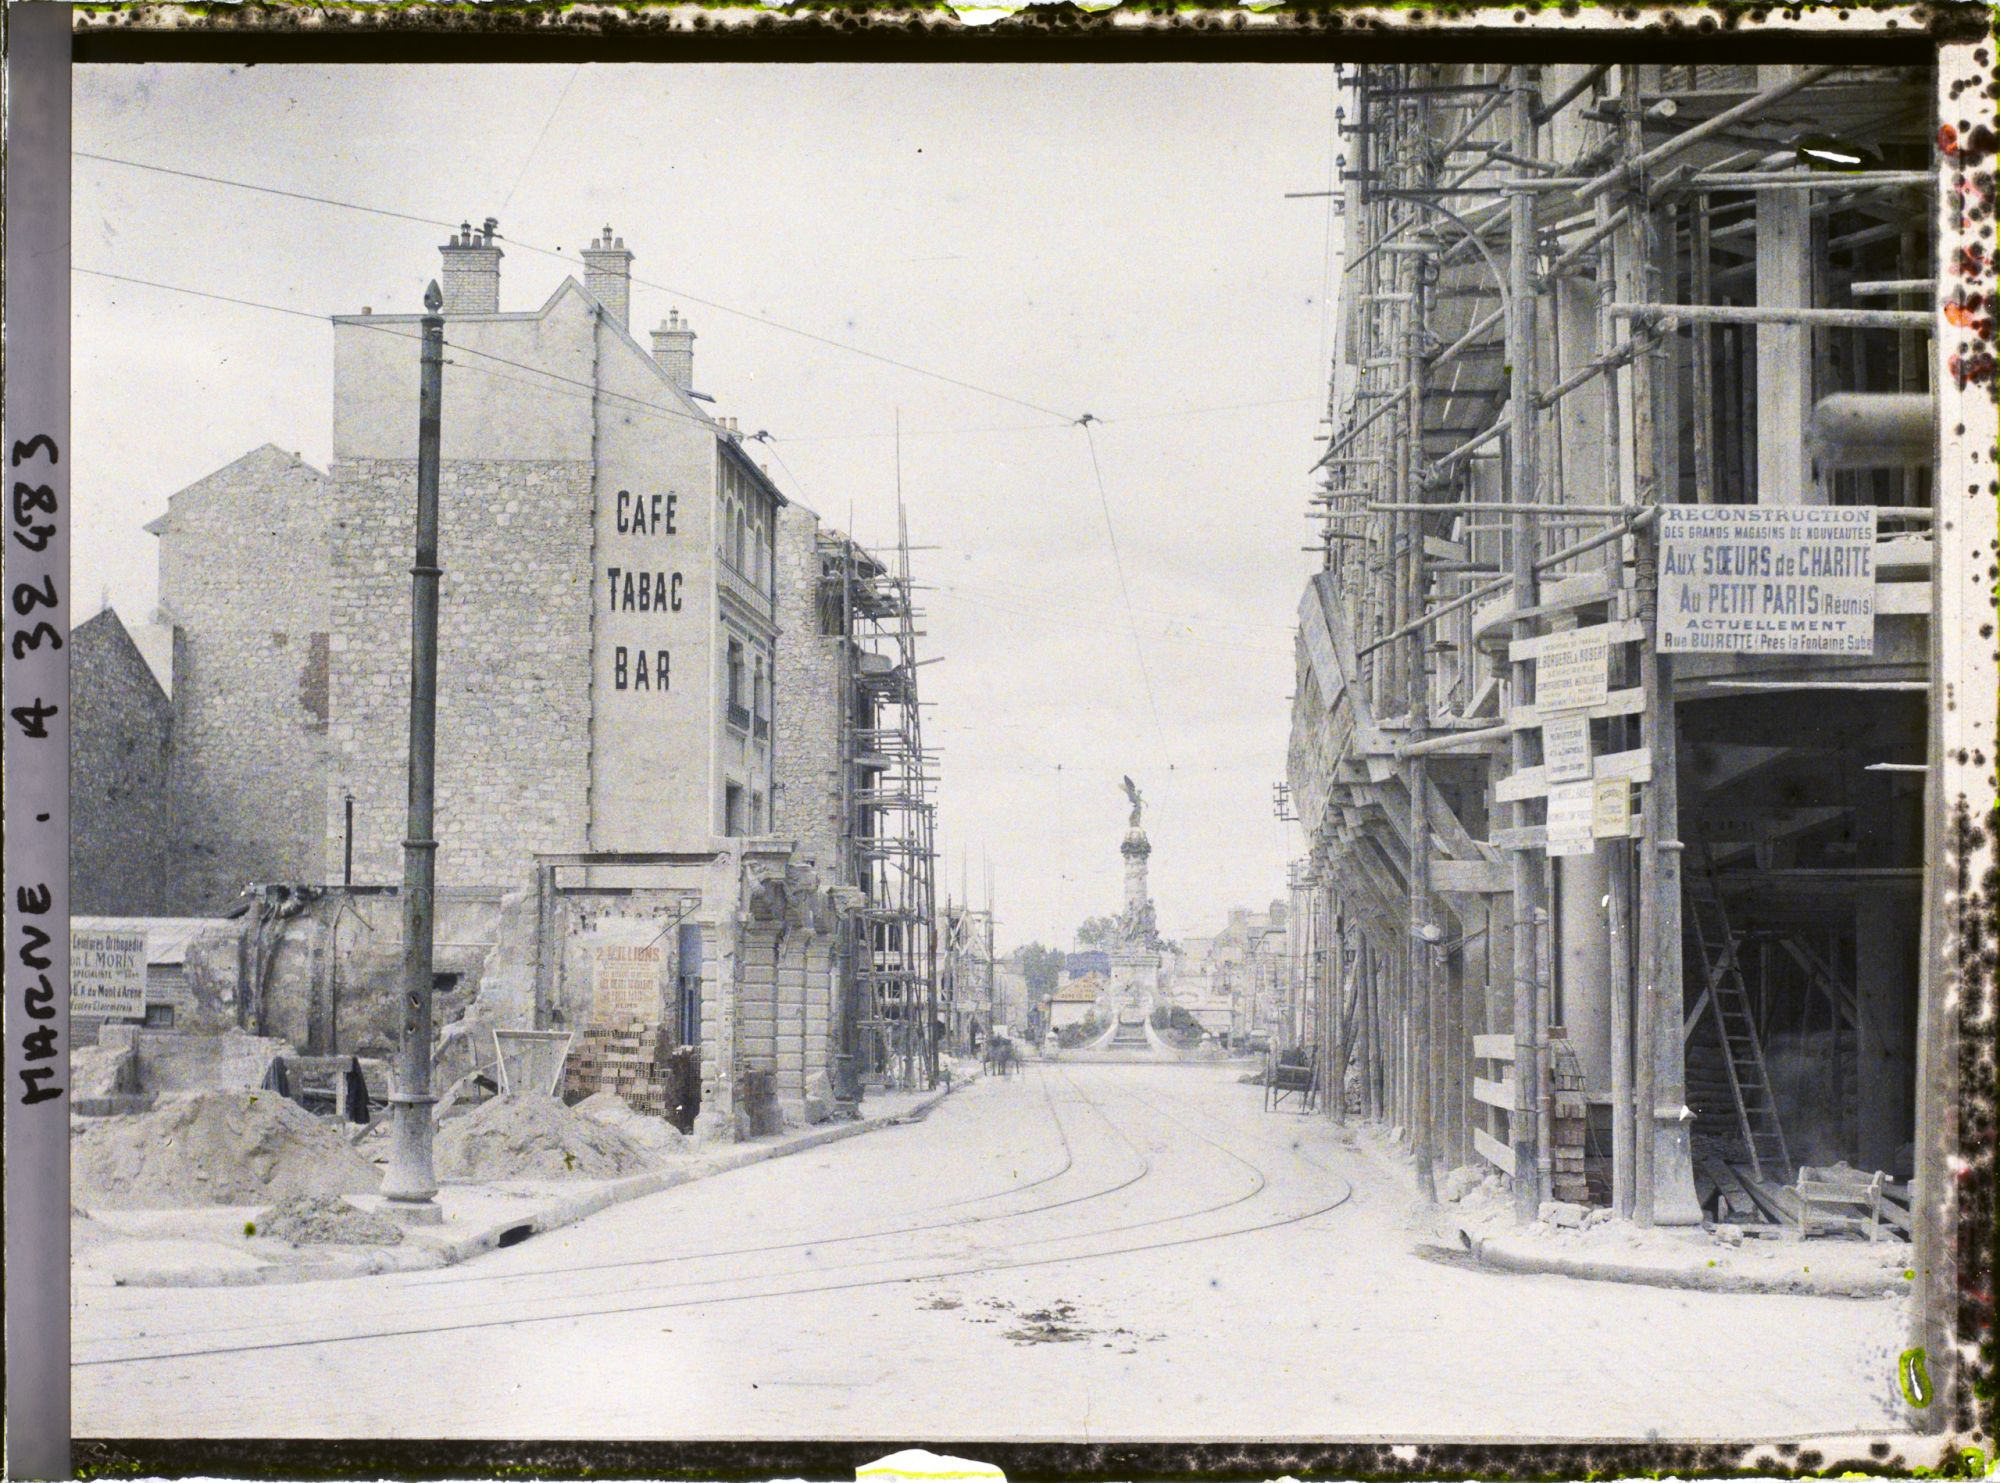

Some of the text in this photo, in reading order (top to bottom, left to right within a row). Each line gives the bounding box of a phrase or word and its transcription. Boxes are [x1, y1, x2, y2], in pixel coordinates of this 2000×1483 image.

[1667, 508, 1870, 522] RECONSTRUCTION
[1664, 526, 1684, 539] DES
[1689, 526, 1729, 539] GRANDS
[1734, 527, 1785, 539] MAGASINS
[1790, 527, 1802, 539] DE
[1775, 553, 1794, 577] de
[608, 567, 683, 612] TABAC
[1709, 583, 1757, 614] PETIT
[1763, 584, 1819, 615] PARIS
[1687, 620, 1847, 631] ACTUELLEMENT
[1692, 632, 1752, 649] BUIRETTE
[1789, 634, 1799, 650] la
[1801, 634, 1845, 650] Fontaine
[615, 646, 670, 691] BAR
